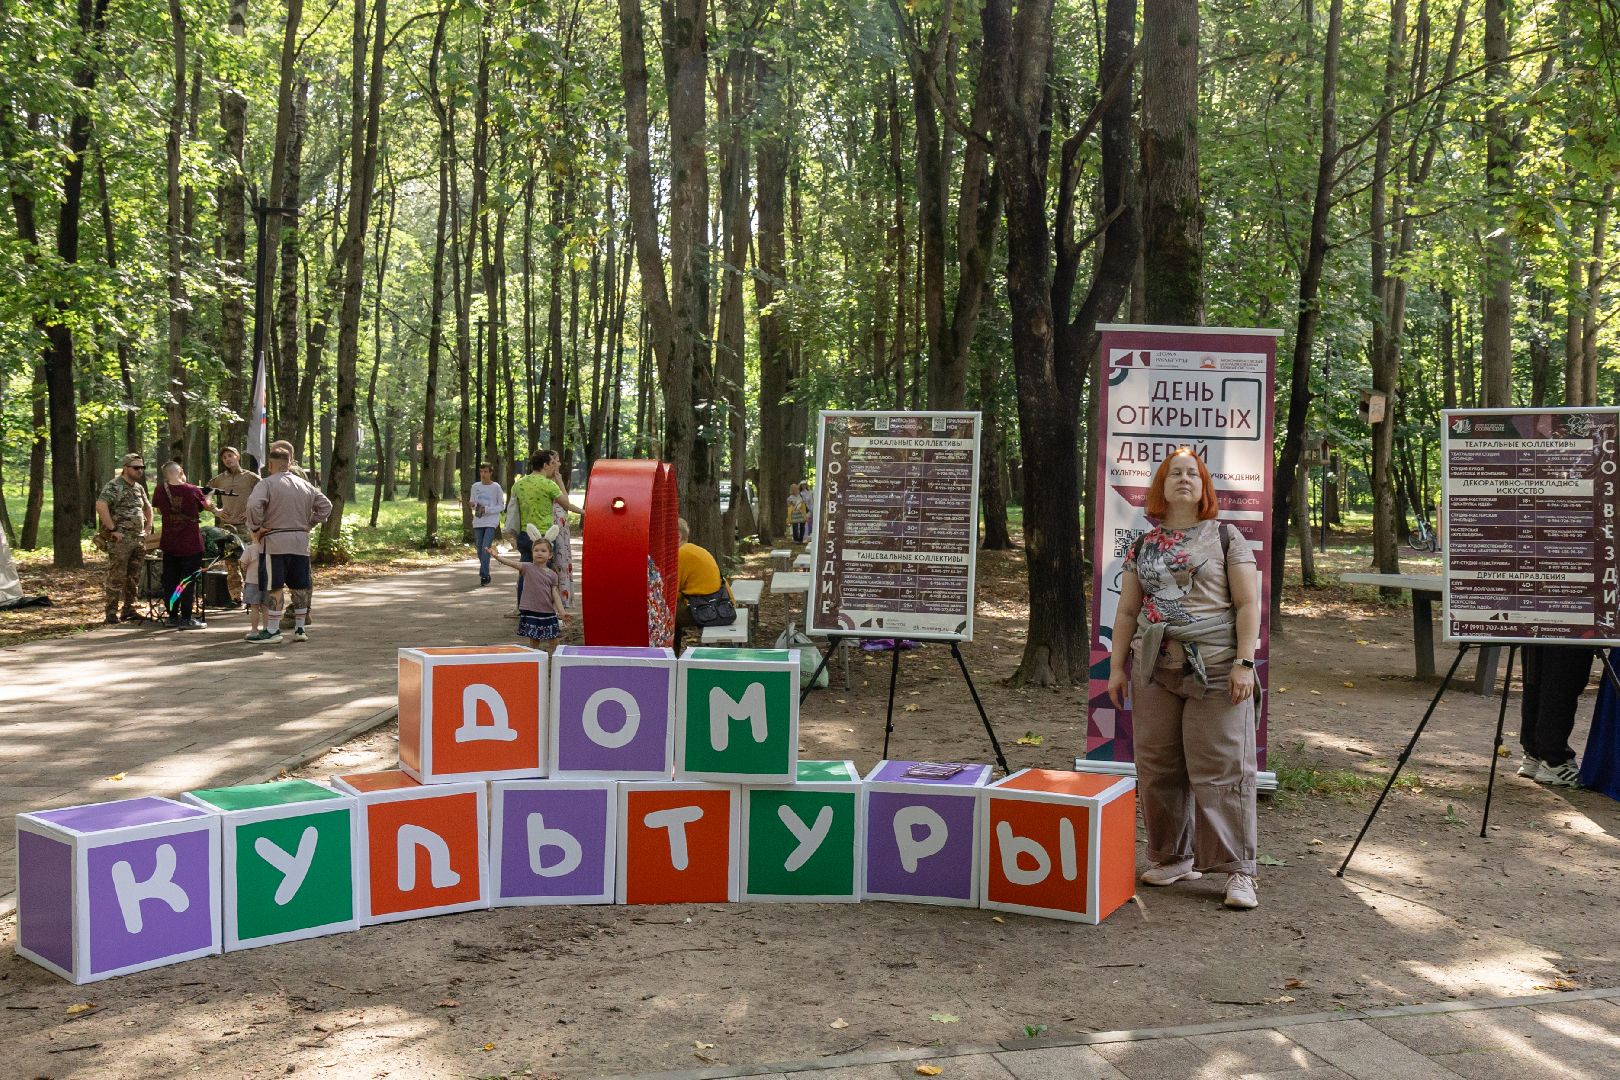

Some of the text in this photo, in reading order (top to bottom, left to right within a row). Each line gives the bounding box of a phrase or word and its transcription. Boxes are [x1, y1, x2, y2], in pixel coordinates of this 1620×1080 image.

[1152, 381, 1214, 403] ДЕНЬ
[1116, 405, 1251, 429] ОТКРЫТЫХ
[869, 439, 912, 447] ВОКАЛЬНЫЕ
[1464, 441, 1576, 449] ТЕАТРАЛЬНЫЕ КОЛЛЕКТИВЫ
[1117, 439, 1208, 465] ДВЕРЙ
[1210, 472, 1260, 481] УЧРЕЖДЕНИЙ
[1462, 479, 1579, 488] ДЕКОРАТИВНО-ПРИКЛАДНОЕ
[1496, 487, 1544, 495] ИСКУССТВО
[1228, 497, 1260, 505] РАДОСТЬ
[822, 442, 842, 614] СОЗВЕЗДИЕ
[1601, 440, 1617, 627] СОЗВЕЗДИЕ
[857, 551, 963, 562] ТАНЦЕВАЛЬНЫЕ КОЛЛЕКТИВЫ
[1477, 571, 1566, 580] ДРУГИЕ НАПРАВЛЕНИЯ
[455, 682, 768, 752] ДОМ
[111, 804, 1077, 934] КУЛЬТУРЫ
